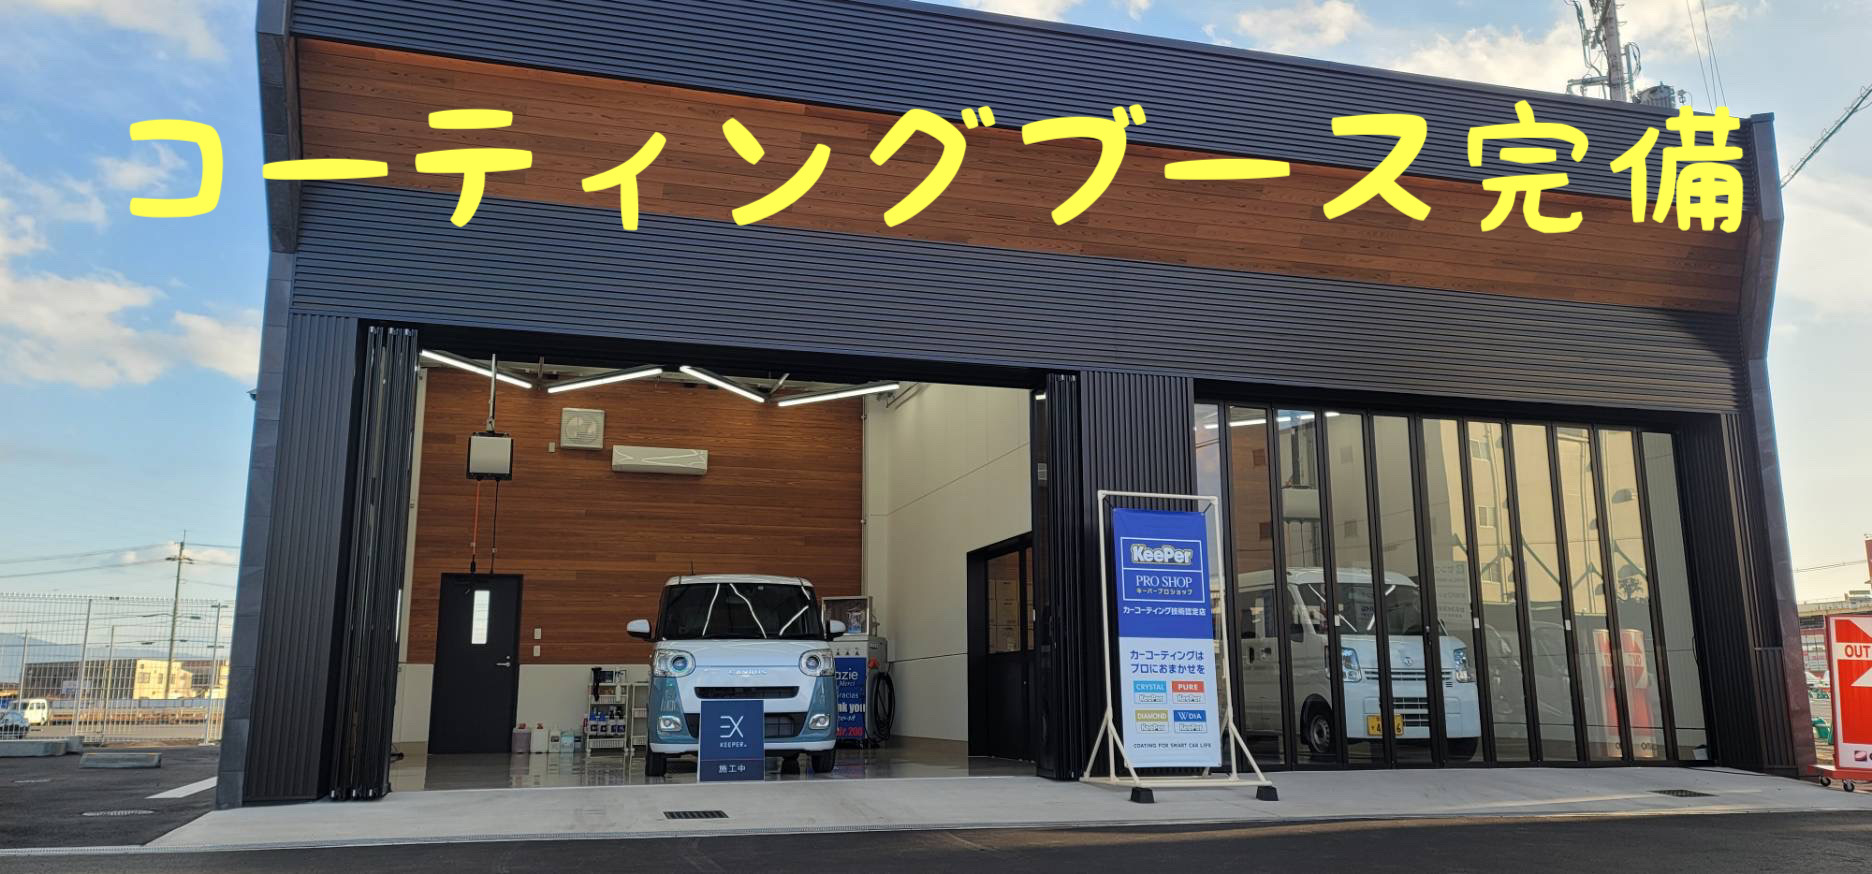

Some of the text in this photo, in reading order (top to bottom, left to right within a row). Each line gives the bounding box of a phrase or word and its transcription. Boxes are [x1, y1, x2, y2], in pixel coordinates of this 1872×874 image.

[1131, 544, 1193, 565] KeePer
[1136, 575, 1193, 588] PRO SHOP
[1130, 650, 1204, 661] カーコーティングは
[1844, 644, 1871, 658] OUT
[1130, 663, 1205, 674] プロにおまかせを
[1177, 683, 1199, 691] PURE
[1137, 712, 1167, 720] DIAMOND
[719, 764, 746, 774] 施工中
